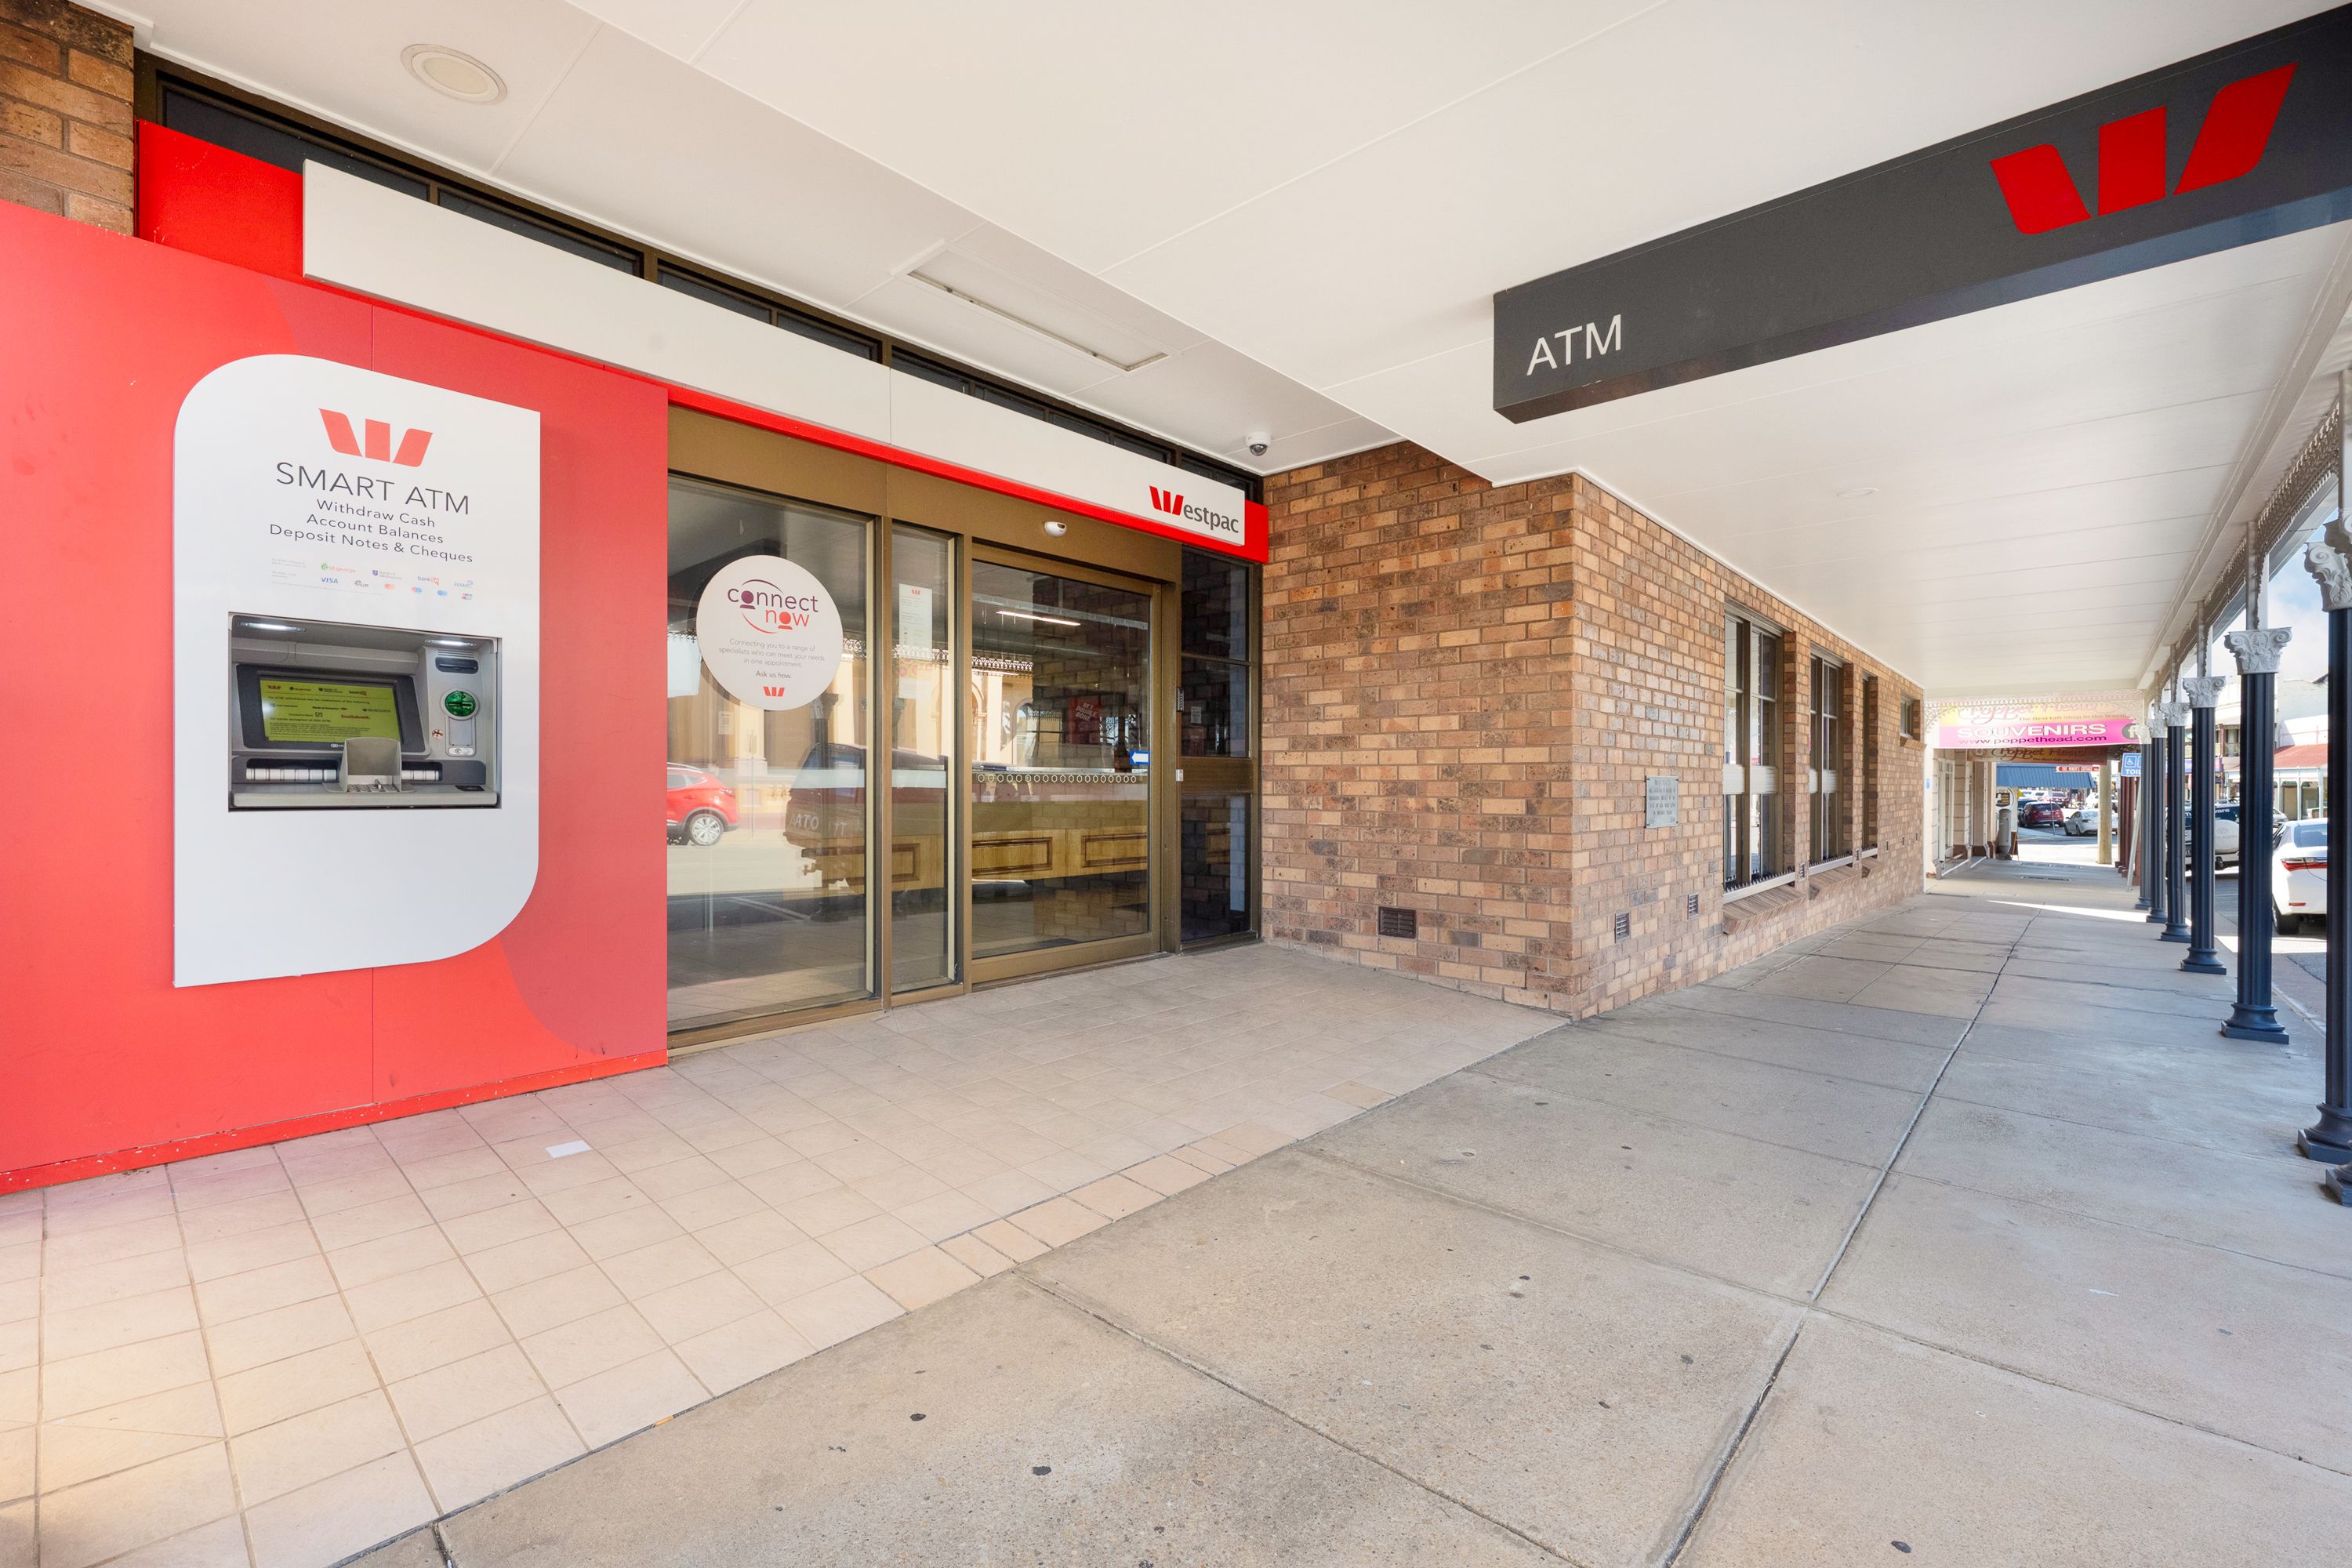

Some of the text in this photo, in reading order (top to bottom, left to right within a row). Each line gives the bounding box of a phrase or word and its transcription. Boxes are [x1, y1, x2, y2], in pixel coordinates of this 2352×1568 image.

[1526, 314, 1621, 376] ATM
[276, 462, 469, 514] SMART ATM
[317, 499, 435, 527] Withdraw Cash
[307, 514, 444, 543] Account Balances
[270, 524, 473, 563] Deposit Notes & Cheques
[728, 588, 818, 612] connect
[765, 609, 810, 630] now
[719, 647, 750, 655] specialists
[729, 637, 765, 649] Connecting
[1958, 724, 2107, 739] SOUVENIRS
[1958, 735, 2107, 745] www.poppethead.com
